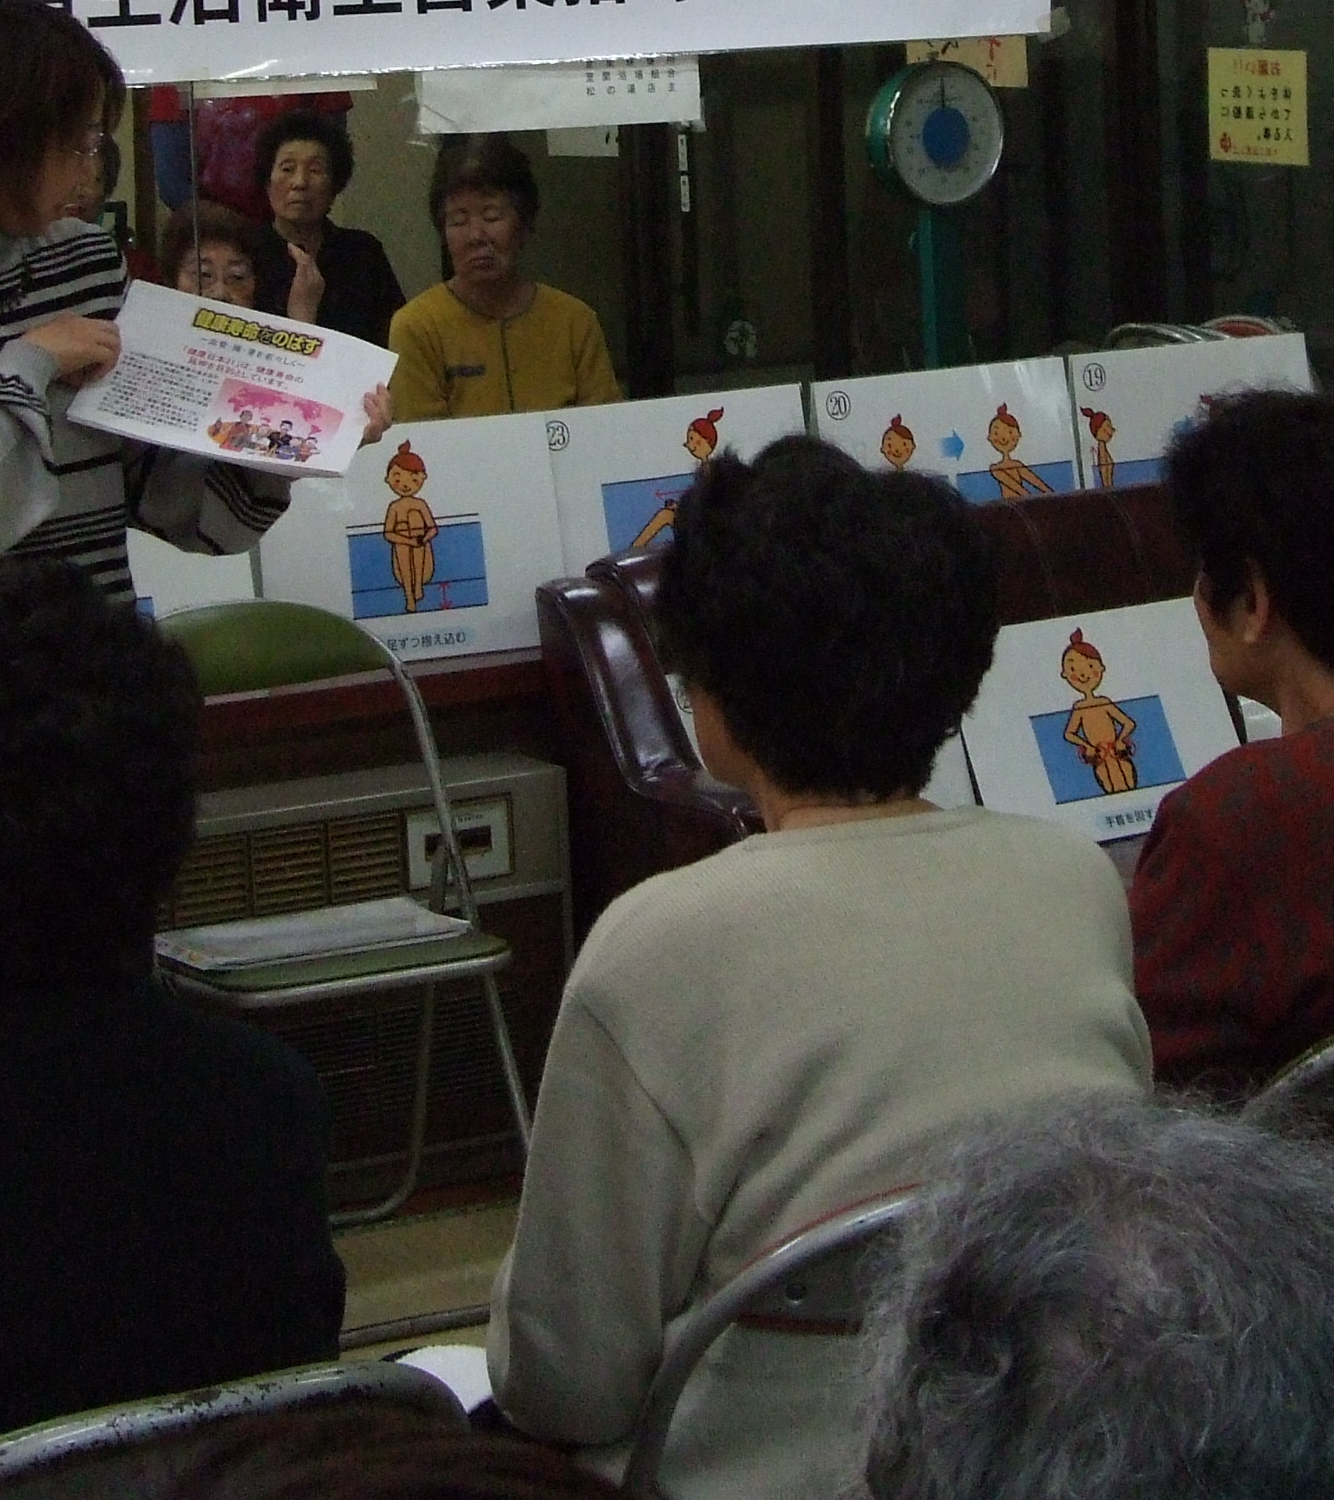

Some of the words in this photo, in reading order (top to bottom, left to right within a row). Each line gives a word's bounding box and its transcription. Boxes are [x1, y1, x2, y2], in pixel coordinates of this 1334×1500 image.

[193, 308, 323, 356] 健康寿命をのばす
